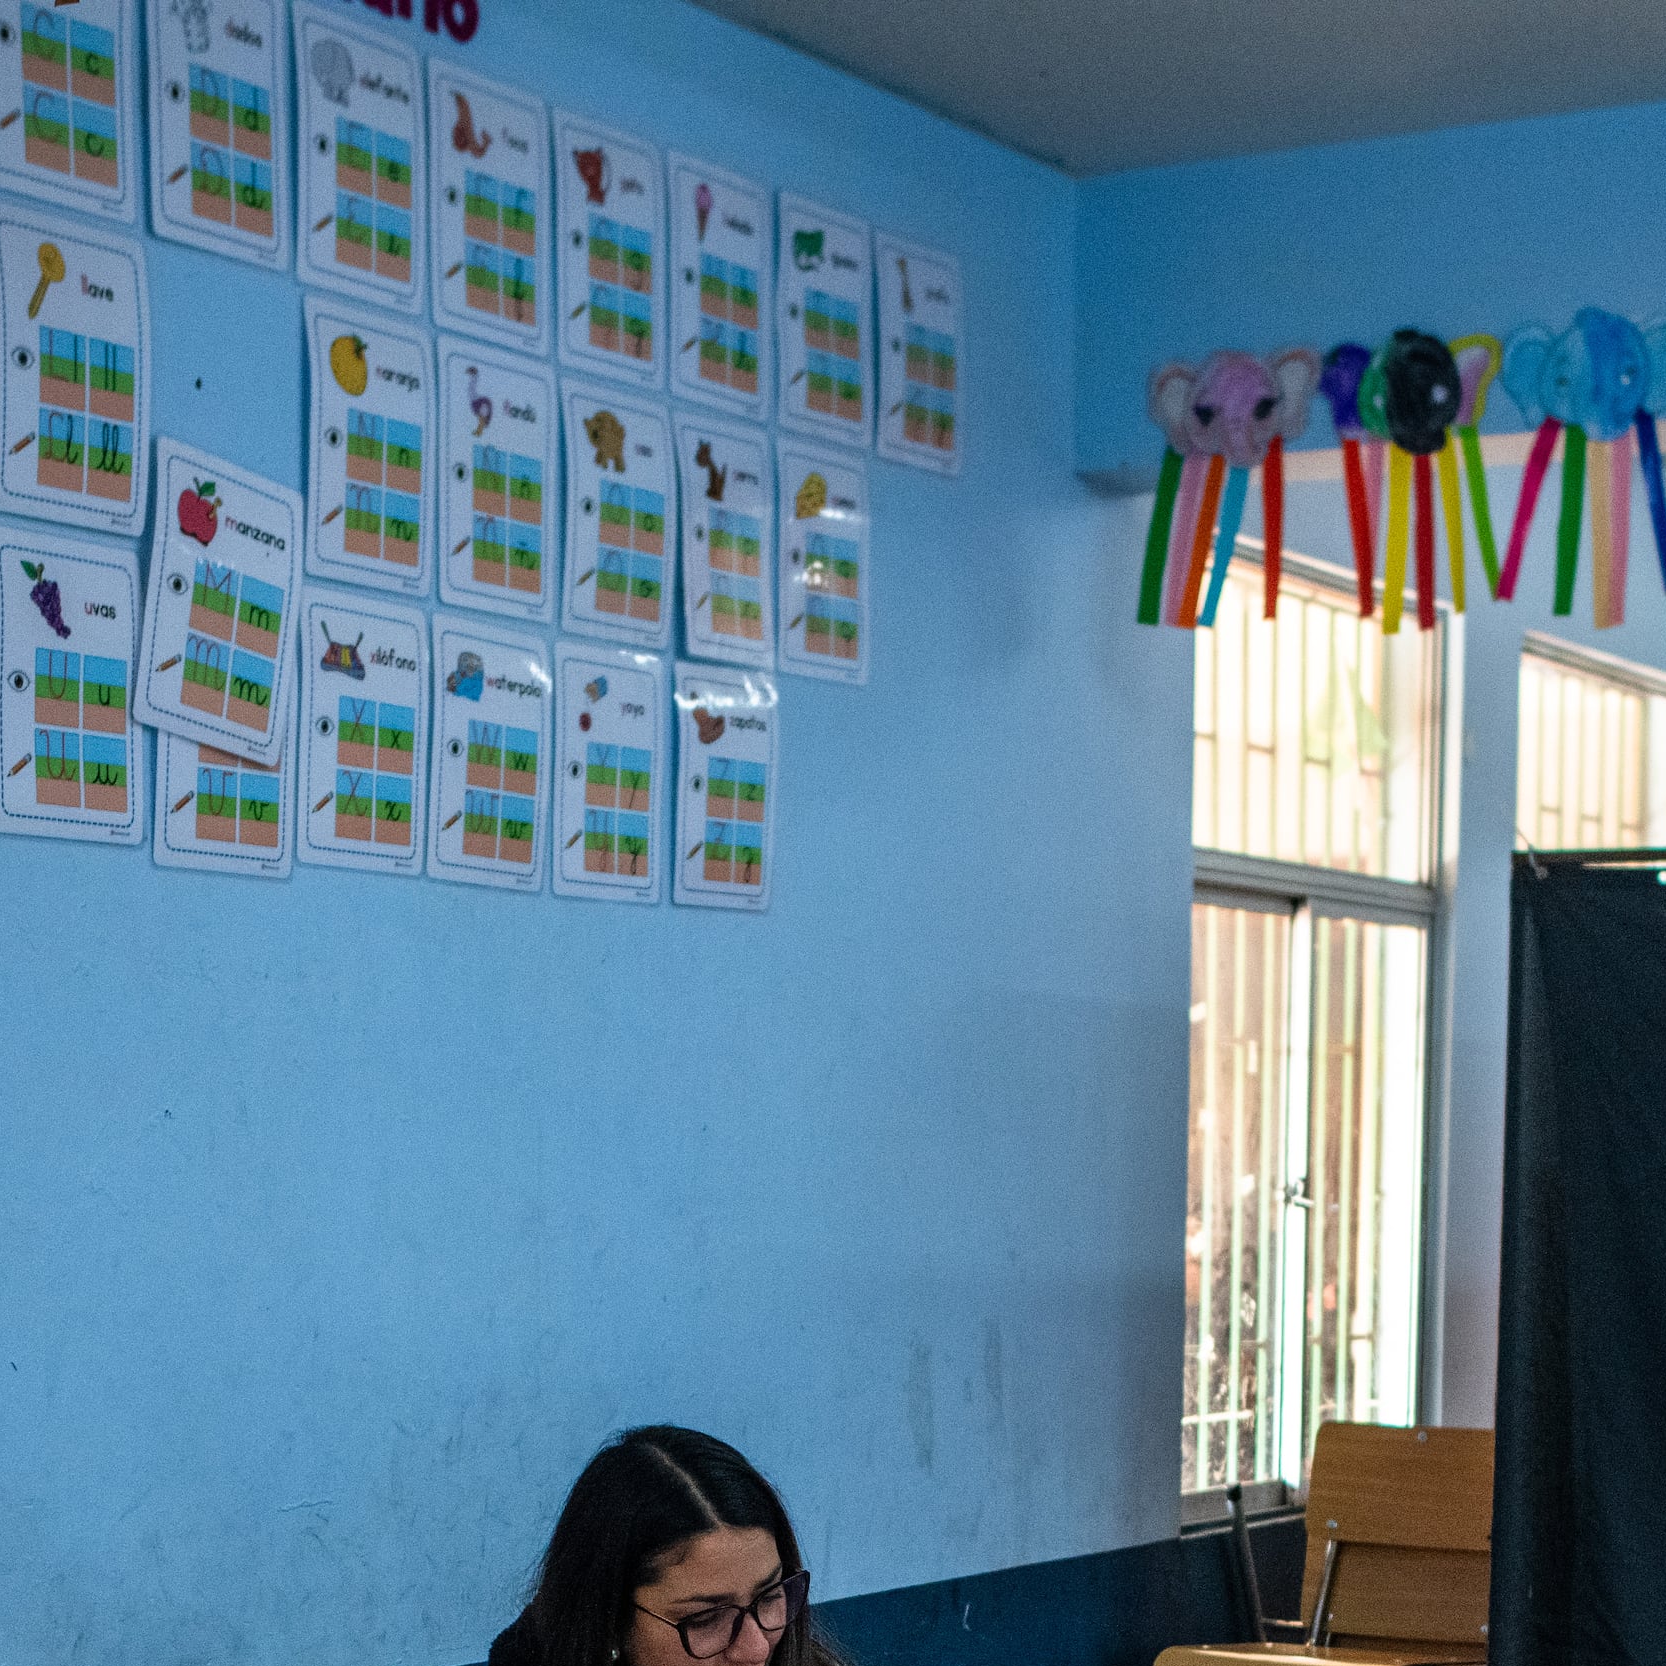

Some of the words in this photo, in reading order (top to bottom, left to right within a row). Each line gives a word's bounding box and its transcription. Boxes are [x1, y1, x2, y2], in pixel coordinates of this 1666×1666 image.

[81, 272, 115, 302] llave
[224, 514, 287, 552] manzana
[84, 601, 117, 620] uvas
[202, 562, 233, 614] M
[248, 604, 271, 632] m
[369, 646, 417, 673] xilófono
[48, 651, 68, 701] U
[98, 683, 111, 707] u
[484, 674, 543, 699] waterpolo
